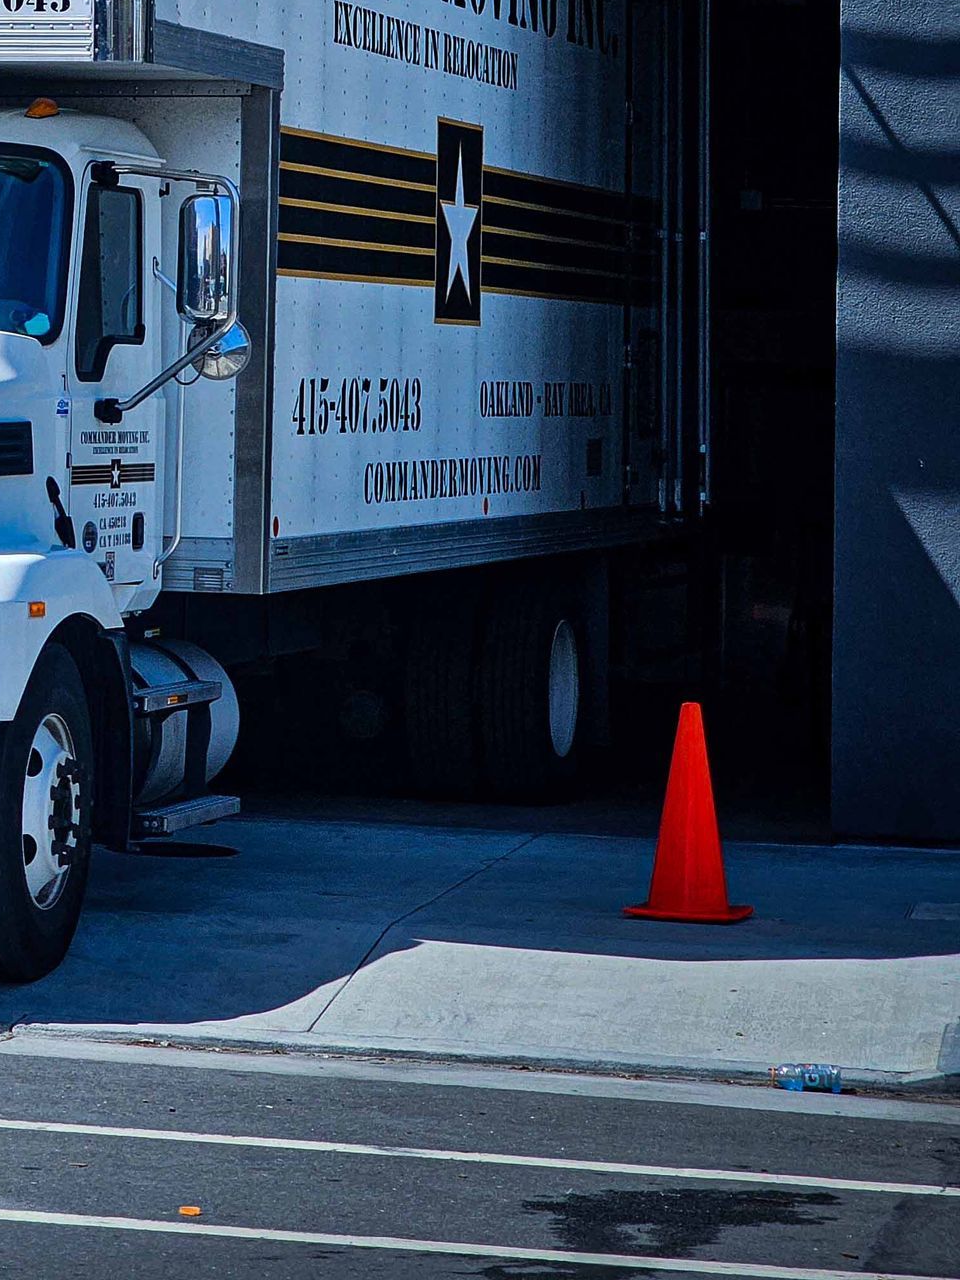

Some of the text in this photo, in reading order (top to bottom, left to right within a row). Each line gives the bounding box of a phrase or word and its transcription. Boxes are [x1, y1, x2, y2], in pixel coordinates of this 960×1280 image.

[334, 0, 518, 91] EXCELLENCE IN RELOCATION
[293, 377, 421, 435] 415-407.5043
[480, 381, 534, 417] OAKLAND
[544, 382, 566, 417] BAY
[81, 431, 116, 444] COMMANDER
[118, 431, 138, 444] MOVING
[93, 492, 137, 508] 415-407.5043
[364, 455, 542, 505] COMMANDERMOVING.COM
